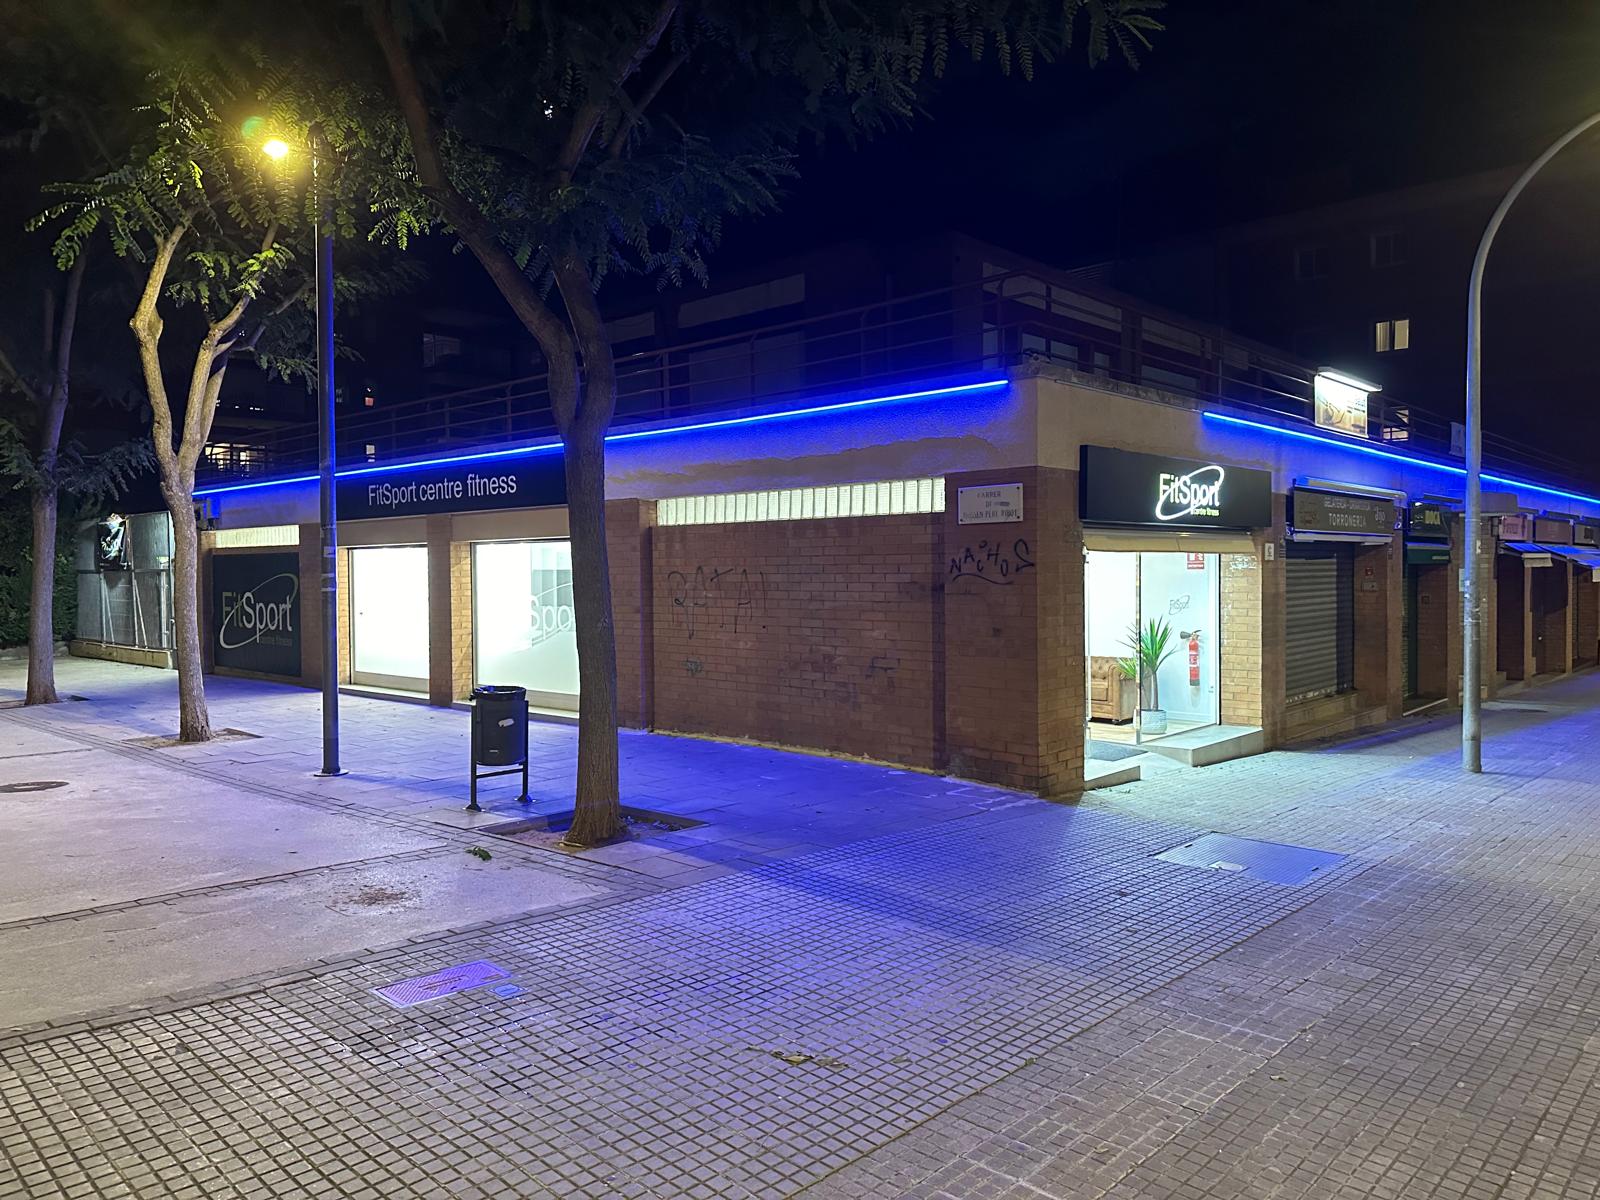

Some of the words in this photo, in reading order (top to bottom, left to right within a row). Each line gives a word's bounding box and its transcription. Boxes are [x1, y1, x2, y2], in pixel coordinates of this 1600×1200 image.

[368, 481, 417, 509] FitSport
[419, 477, 463, 501] centre
[467, 473, 517, 497] fitness
[1160, 473, 1220, 515] FitSport
[222, 592, 293, 644] FitSport
